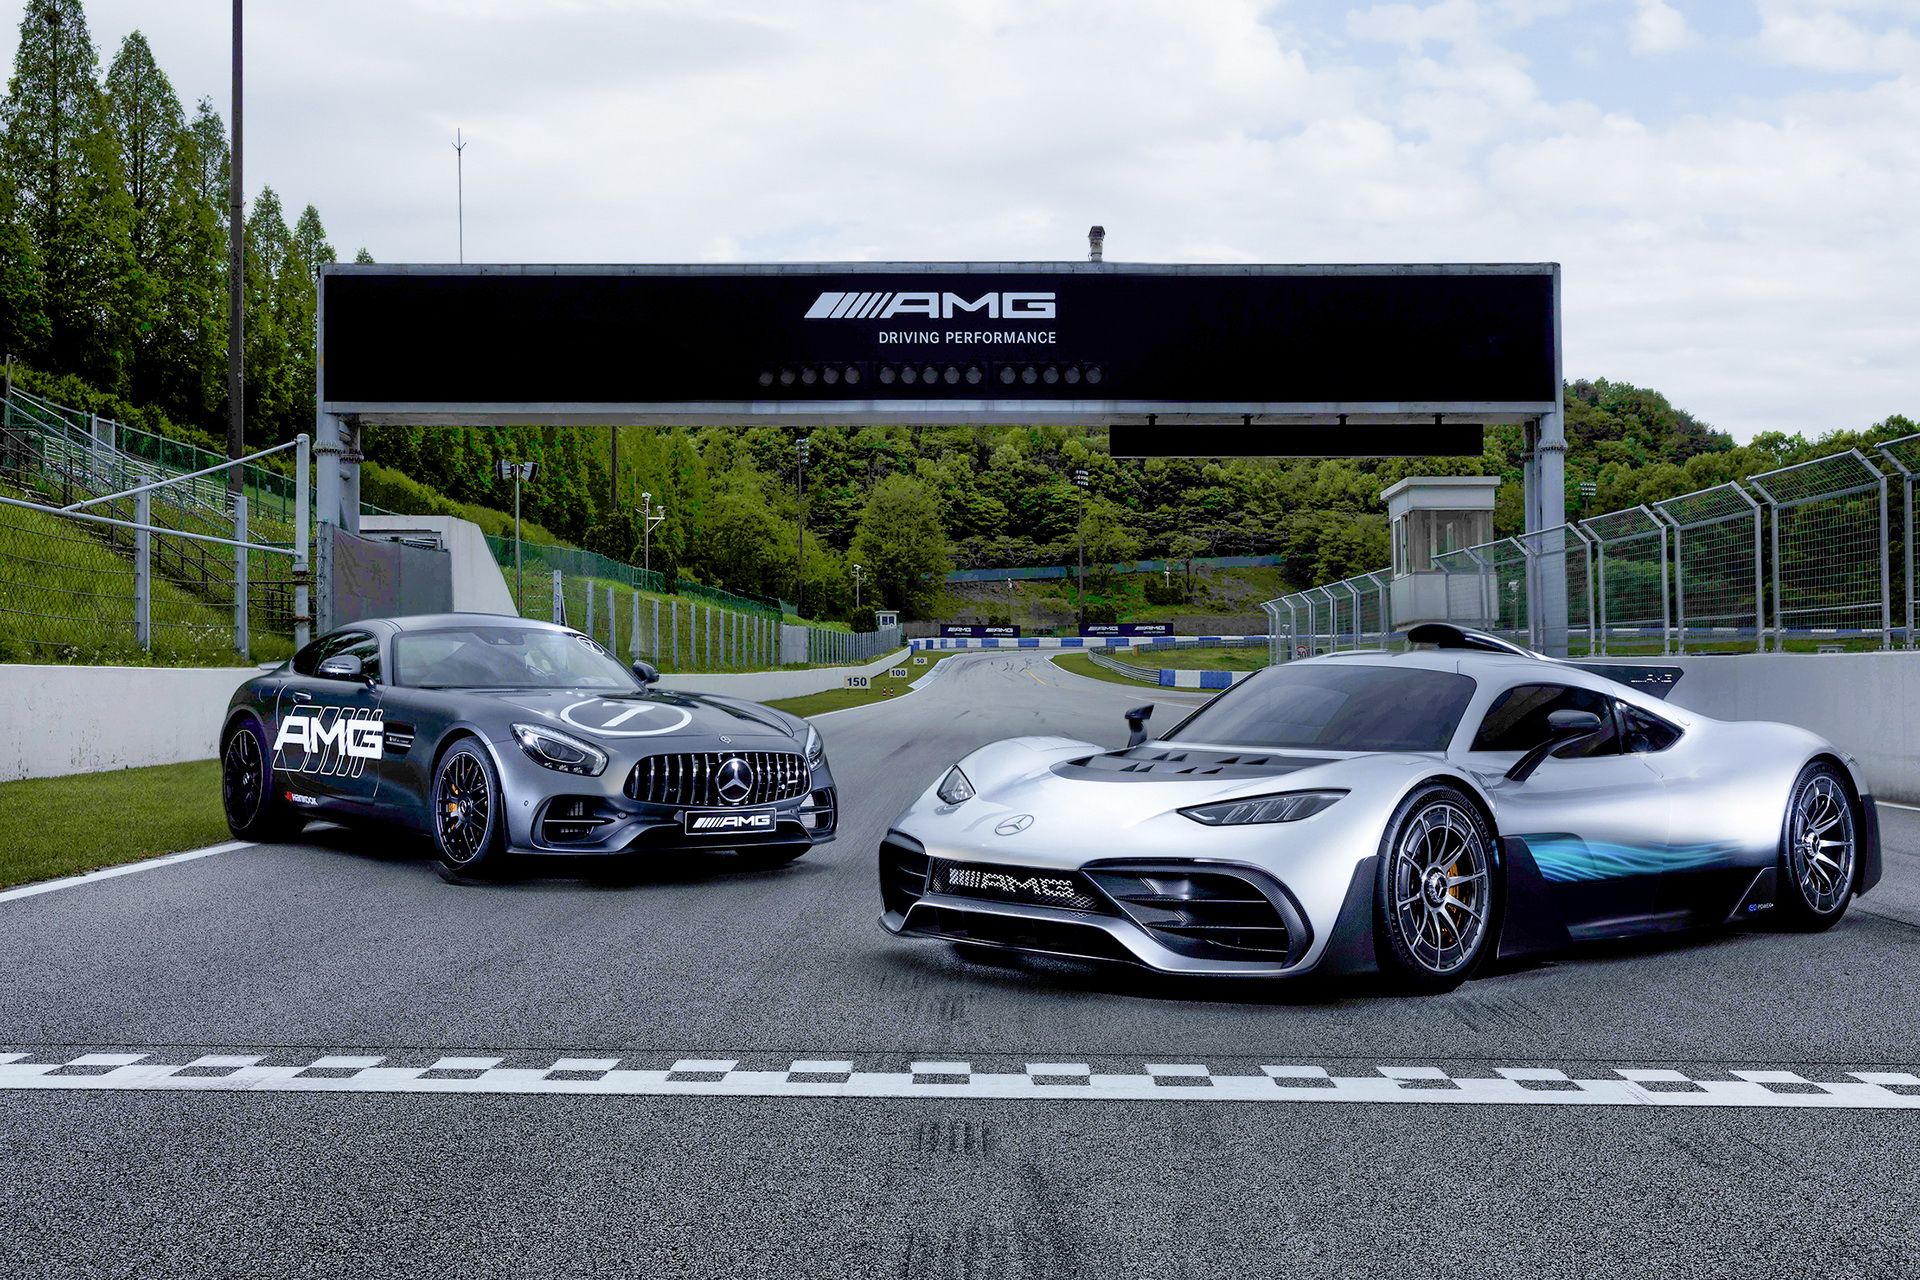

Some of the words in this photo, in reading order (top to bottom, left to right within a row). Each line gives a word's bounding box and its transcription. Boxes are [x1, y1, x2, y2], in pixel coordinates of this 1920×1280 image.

[879, 292, 1056, 319] AMG
[879, 331, 940, 344] DRIVING
[946, 331, 1057, 344] PERFORMANCE
[847, 677, 867, 687] 150
[891, 669, 906, 677] 100
[601, 701, 656, 727] 7
[273, 715, 384, 760] AMG
[722, 814, 770, 828] AMG
[981, 872, 1075, 898] AMG
